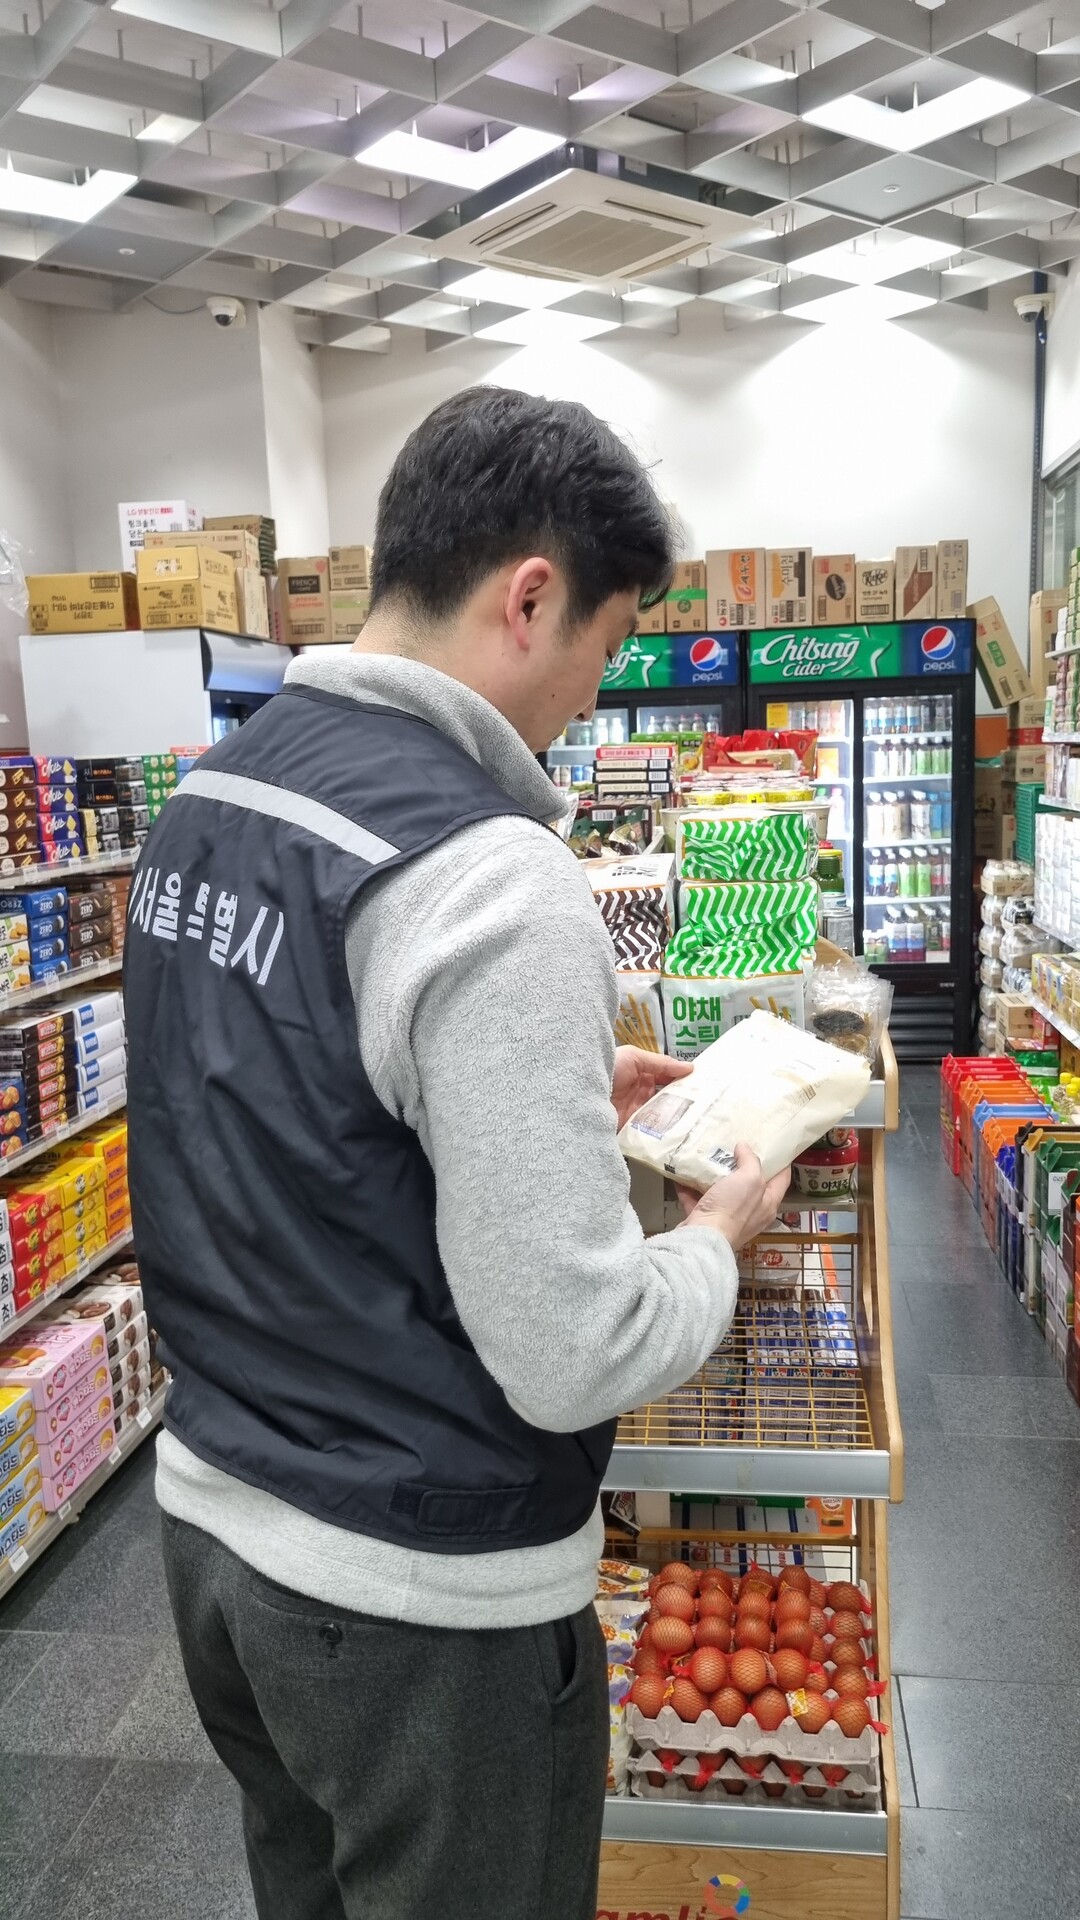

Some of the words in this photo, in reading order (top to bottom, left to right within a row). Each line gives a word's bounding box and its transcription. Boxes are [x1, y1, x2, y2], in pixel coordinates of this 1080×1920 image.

[760, 634, 859, 673] Chilsung
[783, 660, 839, 676] Cider
[923, 662, 956, 672] pepsi
[692, 671, 723, 682] pepsi
[40, 901, 53, 911] ZERO
[81, 904, 93, 915] ZERO
[40, 924, 53, 935] ZERO
[81, 930, 93, 942] ZERO
[40, 948, 53, 959] ZERO
[673, 997, 721, 1022] 야채
[676, 1025, 720, 1046] 스틱
[676, 1050, 704, 1060] Vegeta
